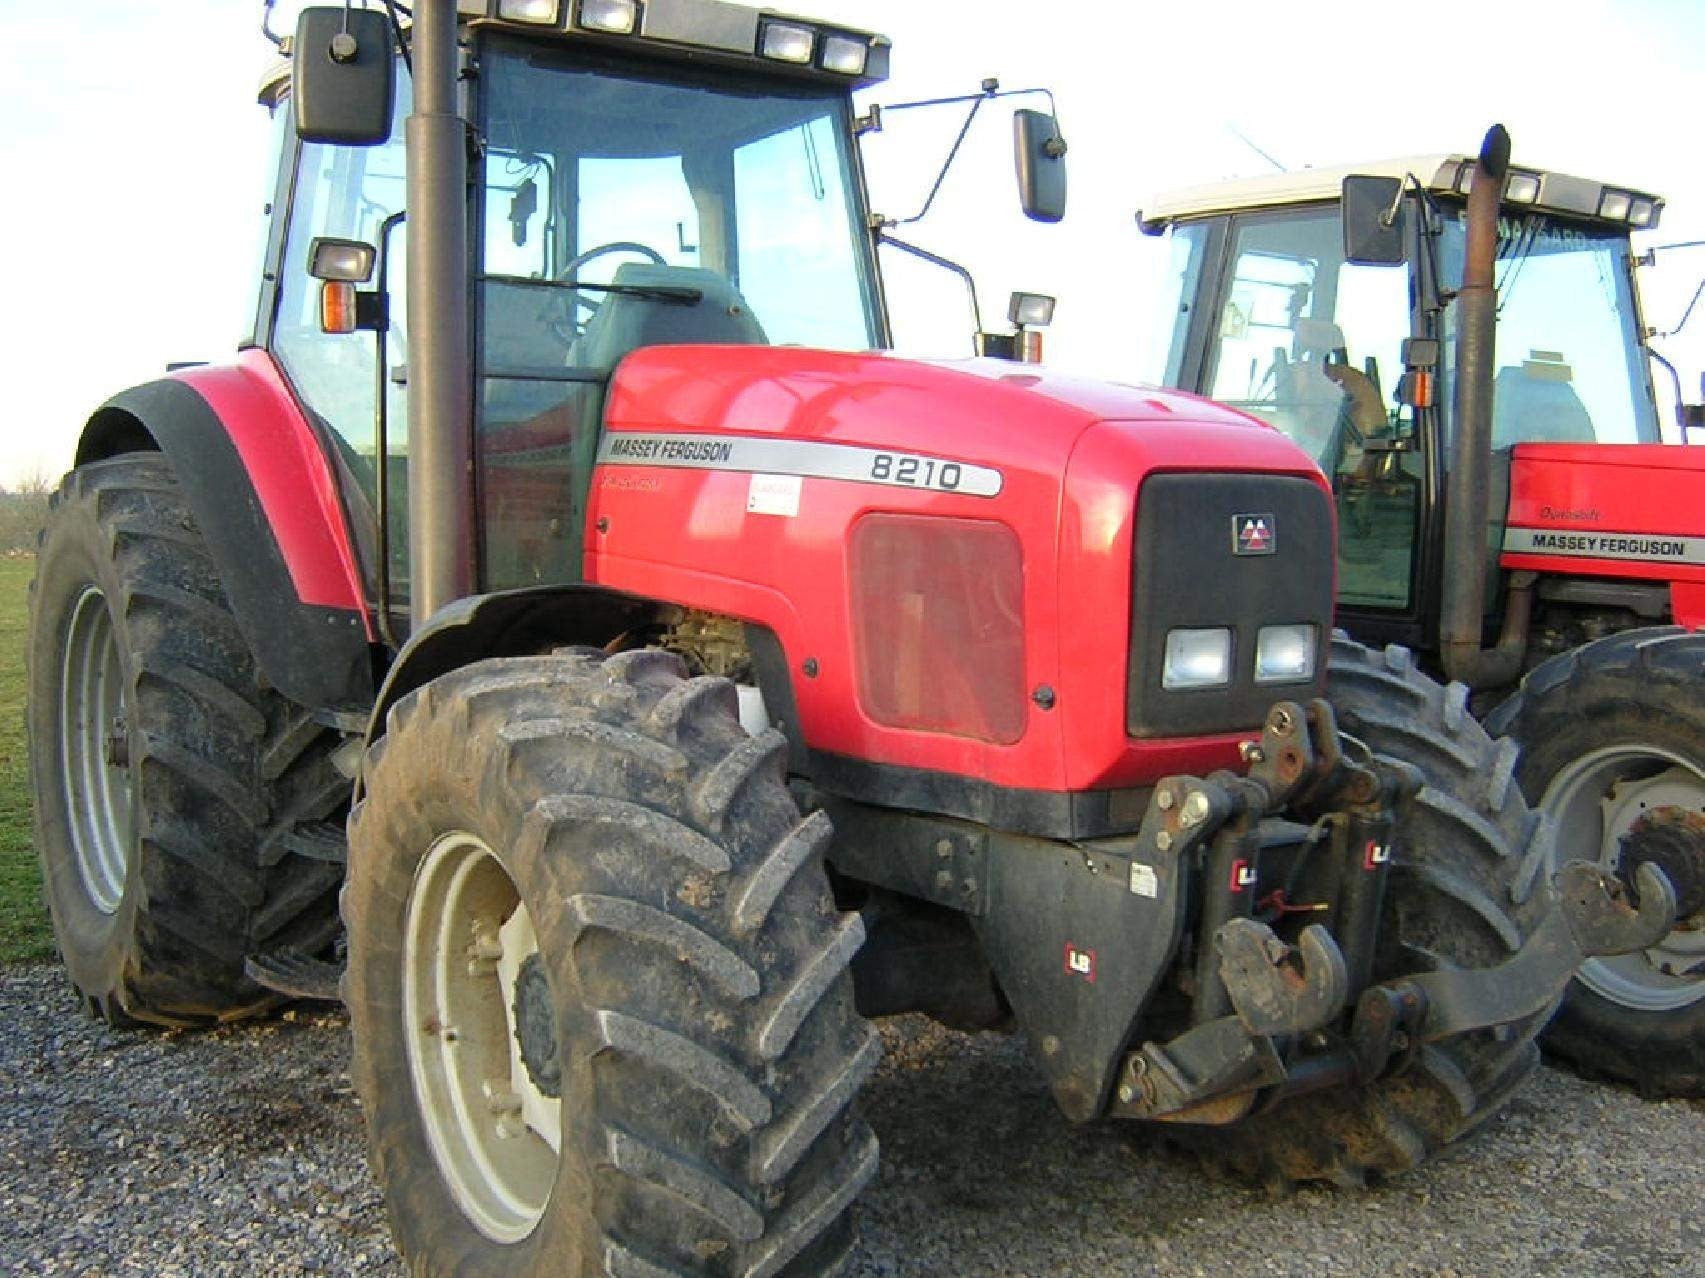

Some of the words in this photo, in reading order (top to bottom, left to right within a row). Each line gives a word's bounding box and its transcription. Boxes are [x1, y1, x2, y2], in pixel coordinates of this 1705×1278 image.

[610, 438, 663, 458] MASSEY
[660, 440, 733, 462] FERGUSON
[871, 453, 961, 491] 8210
[1532, 534, 1598, 551] MASSEY
[1600, 538, 1686, 556] FERGUSON
